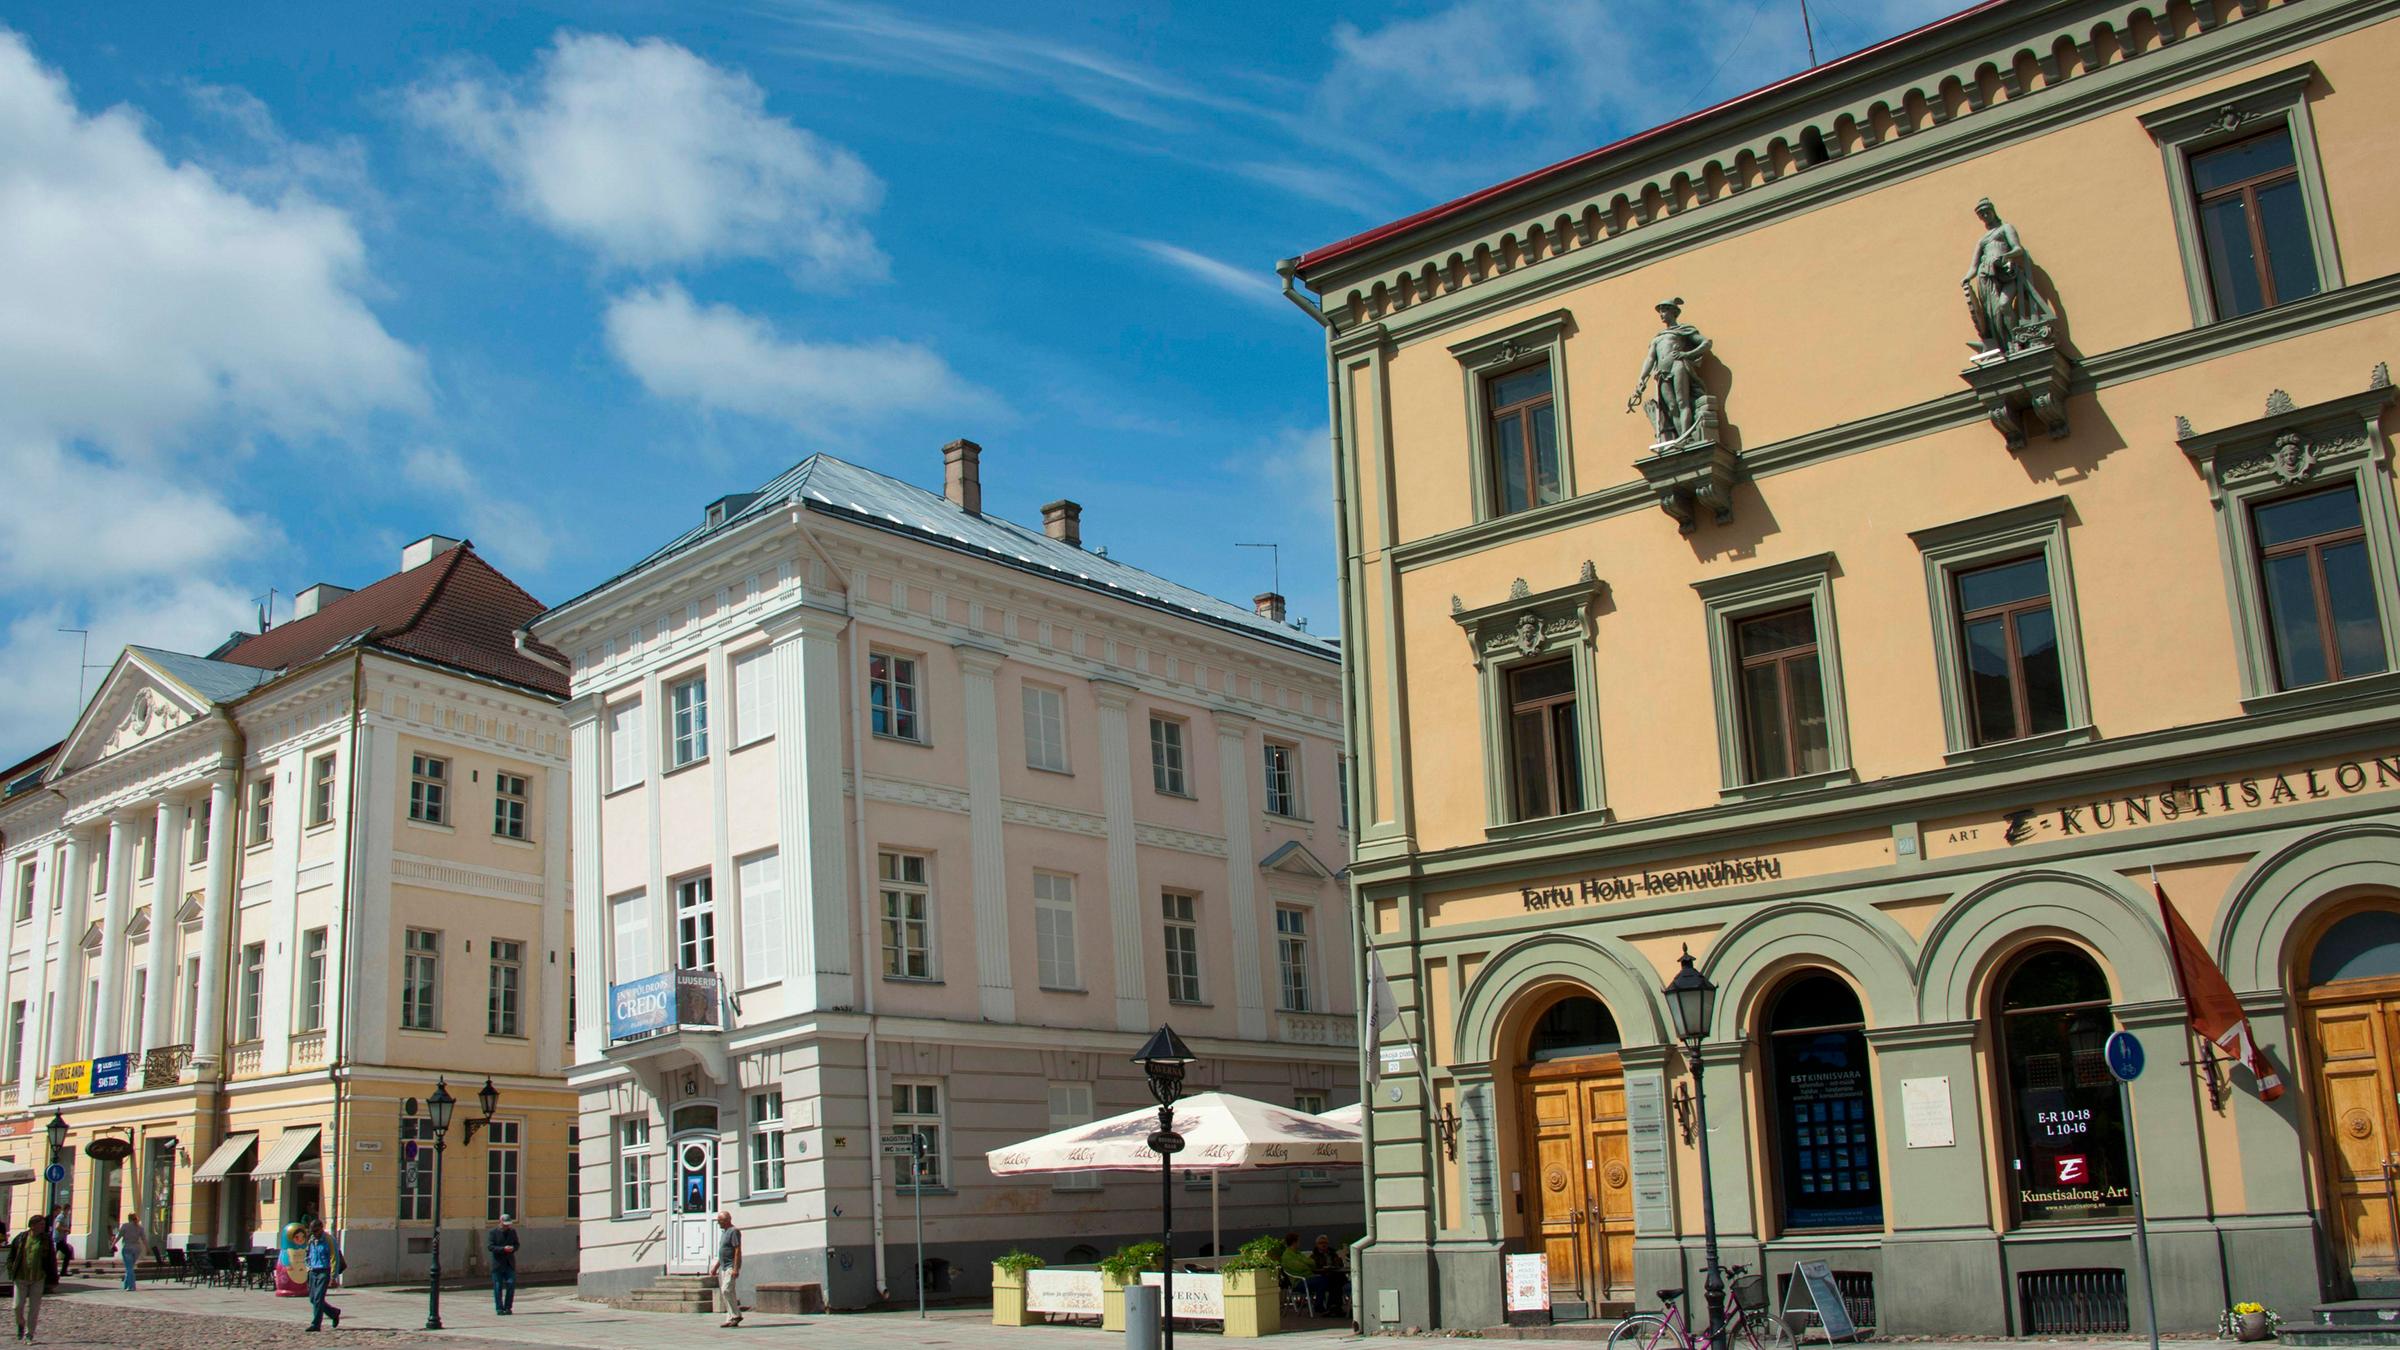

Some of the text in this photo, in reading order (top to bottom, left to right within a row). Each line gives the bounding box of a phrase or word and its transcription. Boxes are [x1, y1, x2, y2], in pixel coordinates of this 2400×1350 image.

[1948, 828, 1979, 844] ART
[1518, 856, 1780, 909] Tartu Hoiu-laenuühistu
[677, 975, 717, 987] LUUSERID
[617, 991, 668, 1020] CREDO
[1390, 1062, 1399, 1071] 20
[2038, 1108, 2091, 1123] E-R 10-18
[2047, 1122, 2087, 1136] L 10-16
[834, 1137, 846, 1145] WC
[2021, 1185, 2129, 1203] Kunstisalong Art
